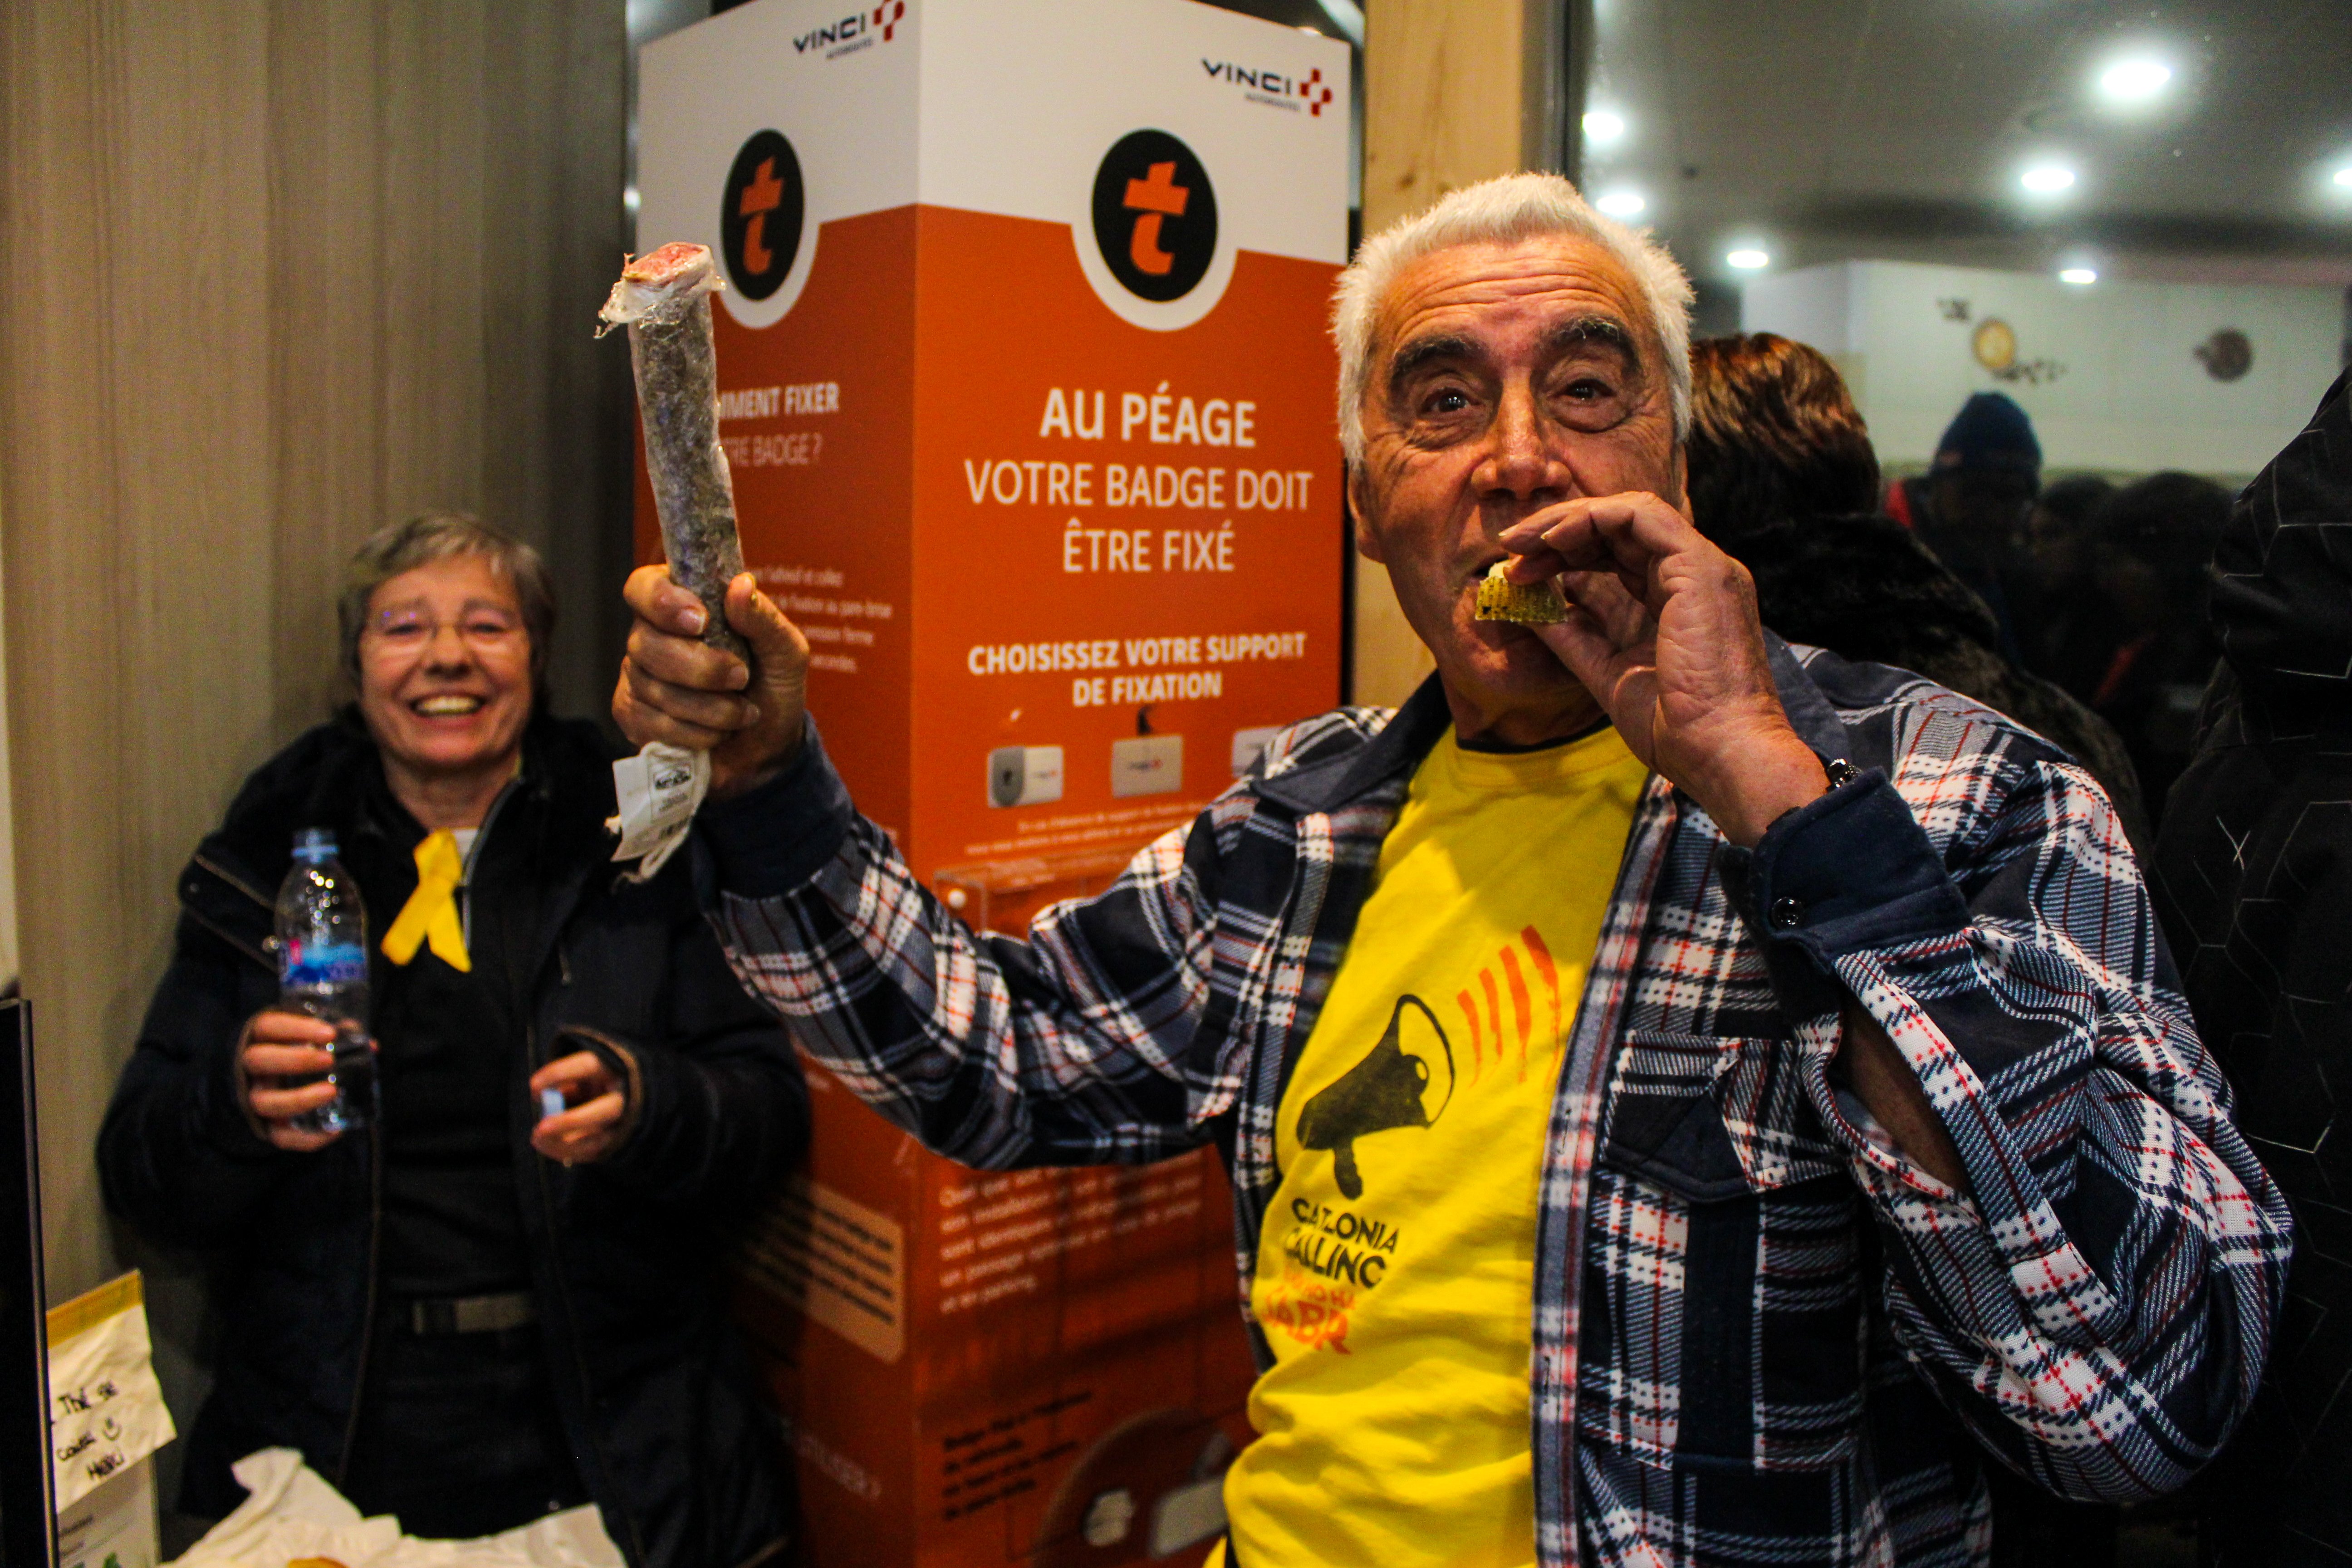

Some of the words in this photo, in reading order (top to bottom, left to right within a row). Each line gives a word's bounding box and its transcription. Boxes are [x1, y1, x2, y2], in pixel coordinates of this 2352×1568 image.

[793, 13, 866, 52] VINCI
[1201, 58, 1291, 96] VINCI
[785, 382, 839, 414] FIXER
[1040, 388, 1104, 439] AU
[1122, 382, 1256, 447] PÉAGE
[753, 433, 809, 466] BADGE
[965, 460, 1093, 505] VOTRE
[1107, 465, 1225, 509] BADGE
[1236, 470, 1313, 510] DOIT
[1064, 517, 1151, 572] ÊTRE
[1163, 521, 1235, 571] FIXÉ
[968, 641, 1119, 675] CHOISISSEZ
[1125, 637, 1201, 666] VOTRE
[1206, 633, 1306, 662] SUPPORT
[1073, 678, 1105, 707] DE
[1112, 672, 1221, 704] FIXATION
